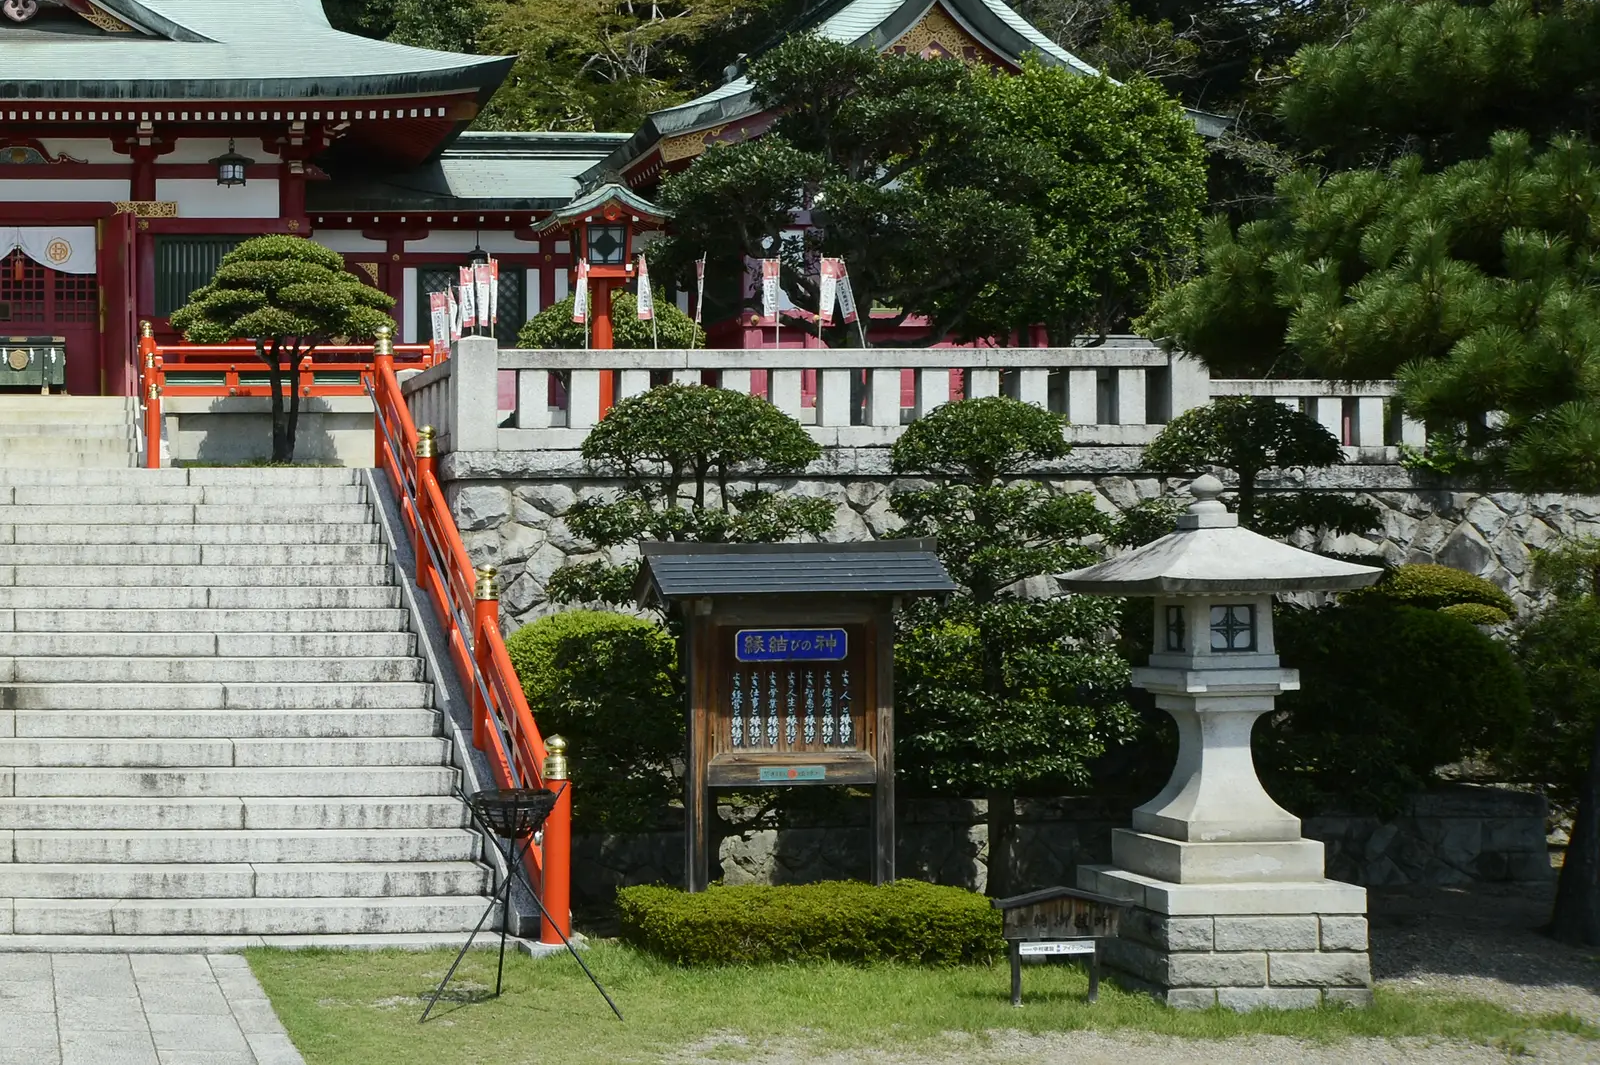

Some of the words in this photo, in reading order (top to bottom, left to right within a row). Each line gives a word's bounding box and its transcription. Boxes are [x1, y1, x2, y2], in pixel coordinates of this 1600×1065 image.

[744, 634, 837, 654] 縁結びの神
[785, 671, 798, 744] よき人生と縁結び
[840, 669, 852, 743] よき人と縁結び
